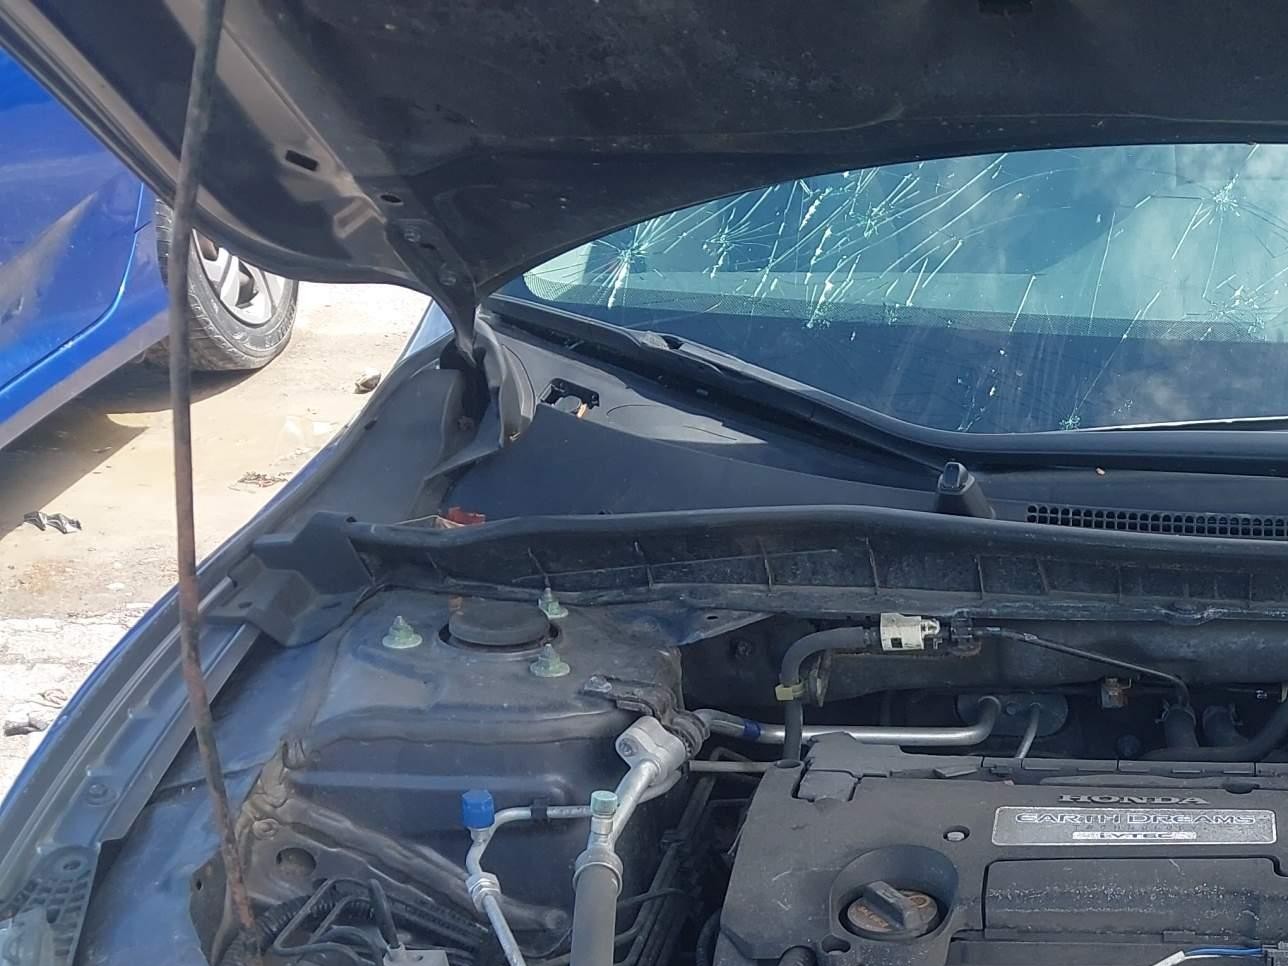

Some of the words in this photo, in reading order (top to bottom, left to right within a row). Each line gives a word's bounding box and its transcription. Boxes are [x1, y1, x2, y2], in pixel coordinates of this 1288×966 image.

[1057, 793, 1210, 805] HONDA
[1015, 812, 1122, 824] EARTH
[1127, 812, 1256, 825] DREAMS
